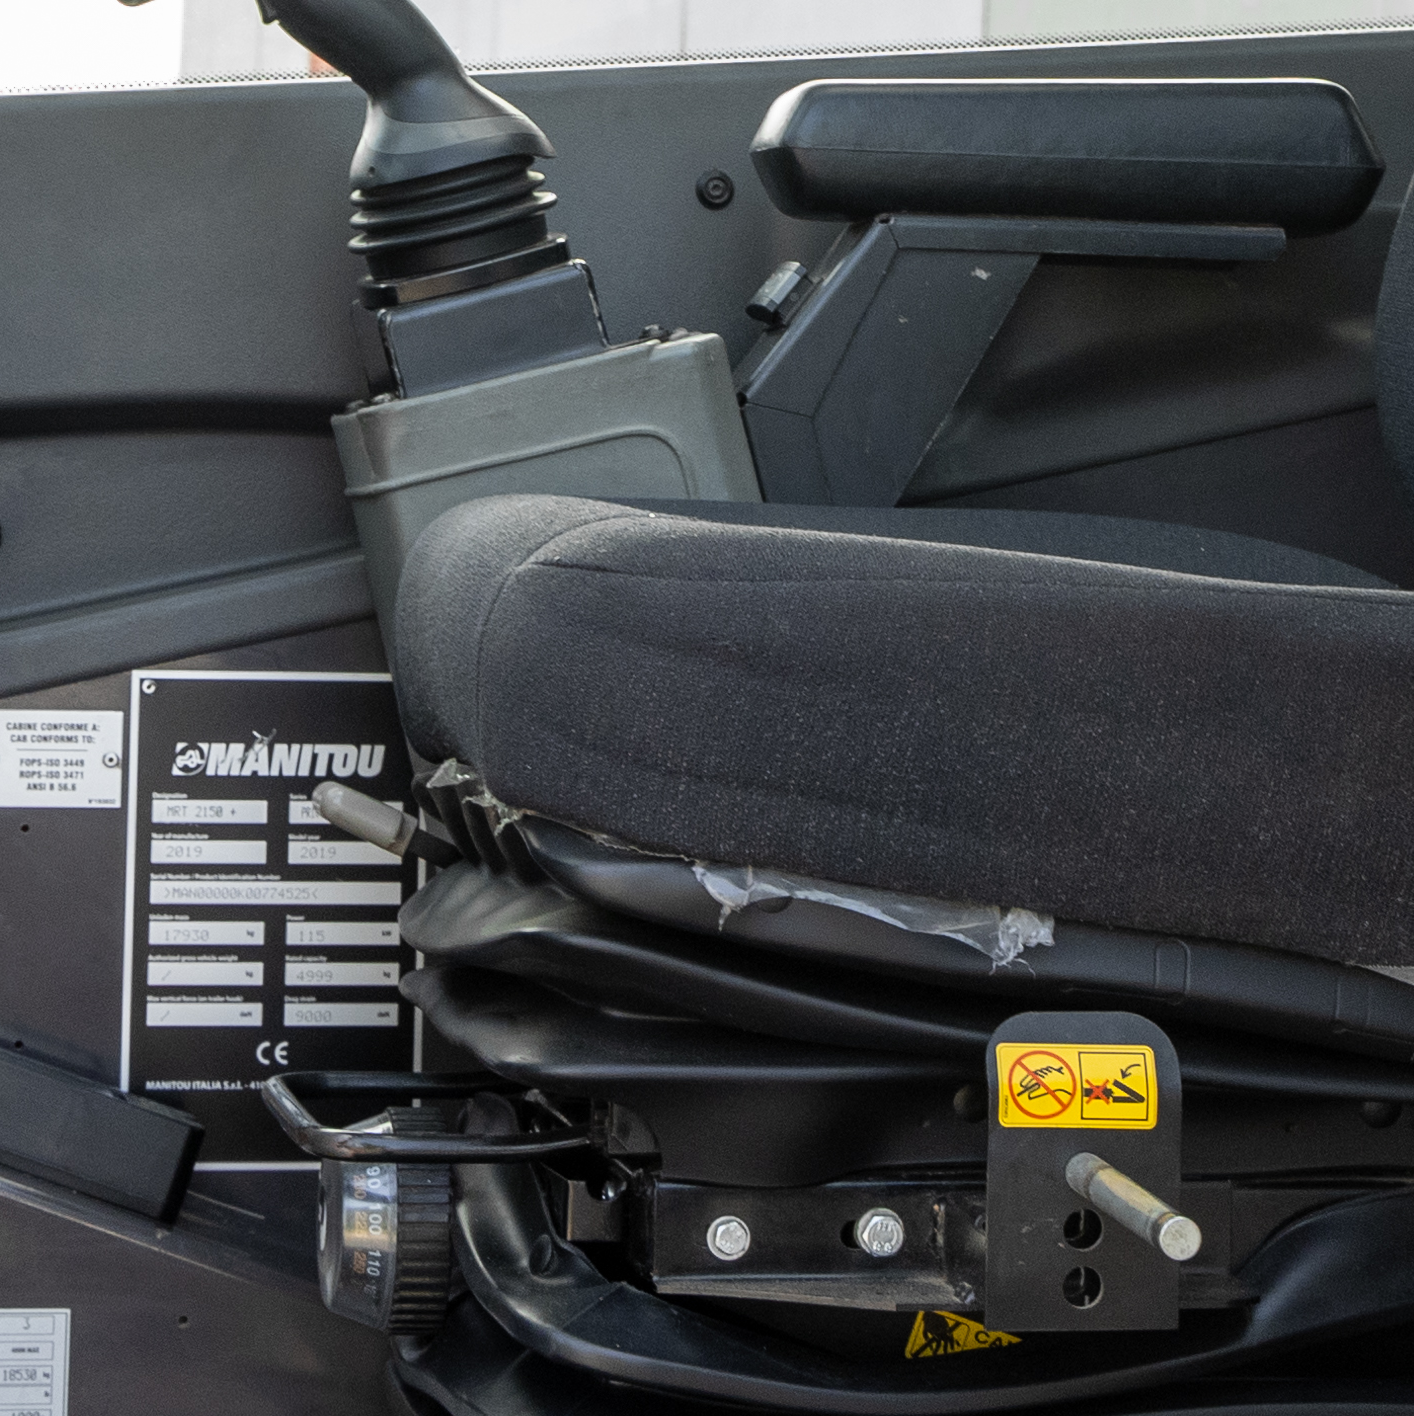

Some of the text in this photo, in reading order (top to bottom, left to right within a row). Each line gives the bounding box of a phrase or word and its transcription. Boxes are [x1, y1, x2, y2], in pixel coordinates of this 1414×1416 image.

[6, 722, 38, 731] CABINE
[40, 723, 89, 731] CONFORME
[10, 734, 28, 743] CAB
[30, 735, 79, 743] CONFORMS
[19, 758, 61, 767] FOPS-ISO
[205, 742, 386, 777] MANITOU
[19, 771, 84, 779] ROPS-ISO 3471
[26, 783, 47, 791] ANSI
[49, 783, 55, 791] B
[167, 805, 188, 817] MRT
[195, 805, 224, 818] 2150
[166, 845, 203, 858] 2019
[300, 846, 337, 859] 2019
[165, 929, 209, 942] 17930
[299, 930, 325, 942] 115
[296, 970, 333, 982] 4999
[295, 1010, 332, 1022] 9000
[256, 1041, 289, 1065] CE
[145, 1080, 192, 1090] MANITOU
[192, 1080, 222, 1090] ITALIA
[366, 1166, 381, 1189] 90
[368, 1203, 382, 1235] 100
[366, 1249, 381, 1277] 110
[3, 1369, 37, 1381] 18530
